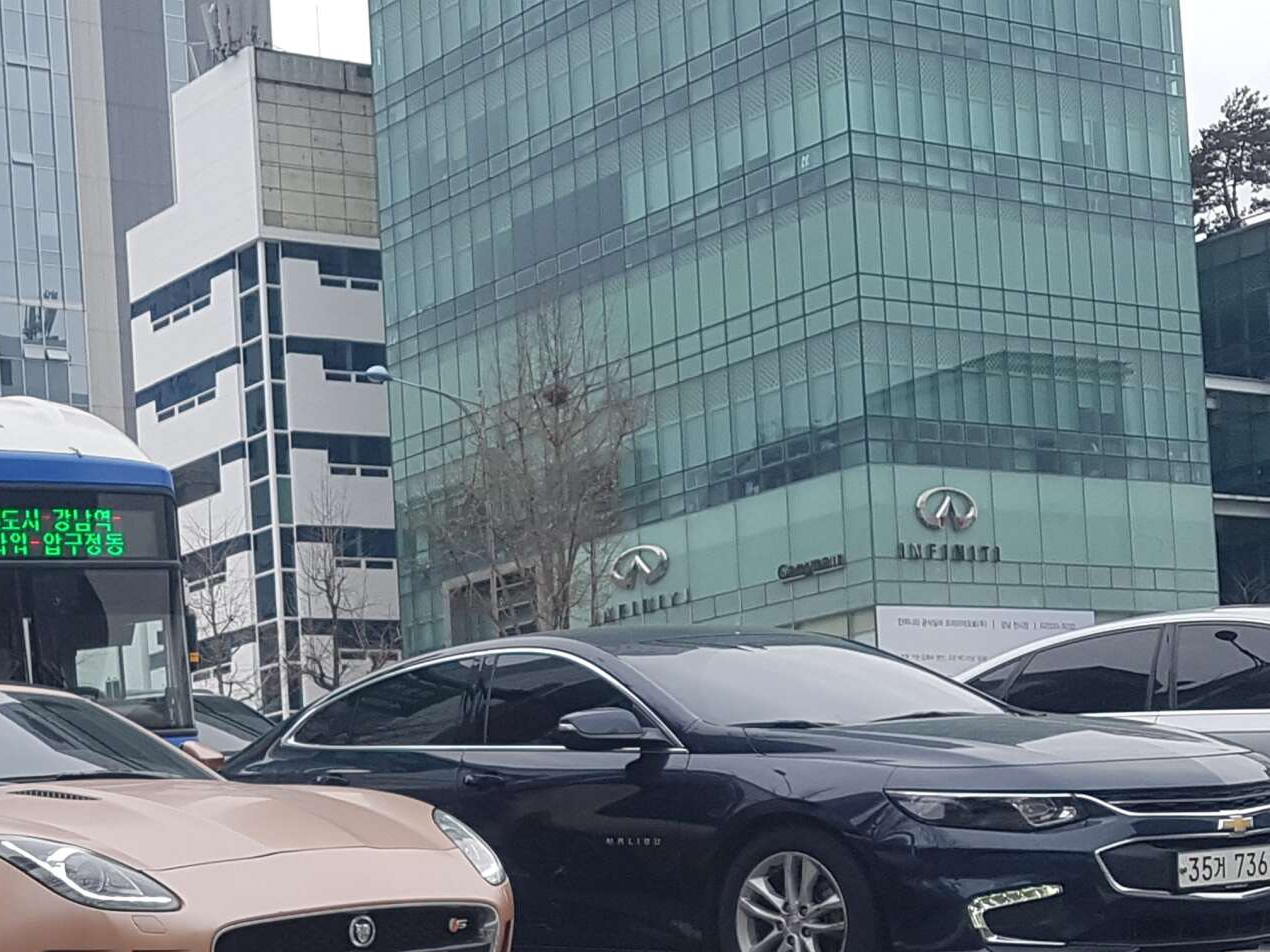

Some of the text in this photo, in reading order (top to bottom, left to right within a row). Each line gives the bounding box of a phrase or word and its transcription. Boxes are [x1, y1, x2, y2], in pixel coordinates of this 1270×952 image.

[897, 541, 1002, 563] INFINITI
[1188, 851, 1268, 882] 35거 736
